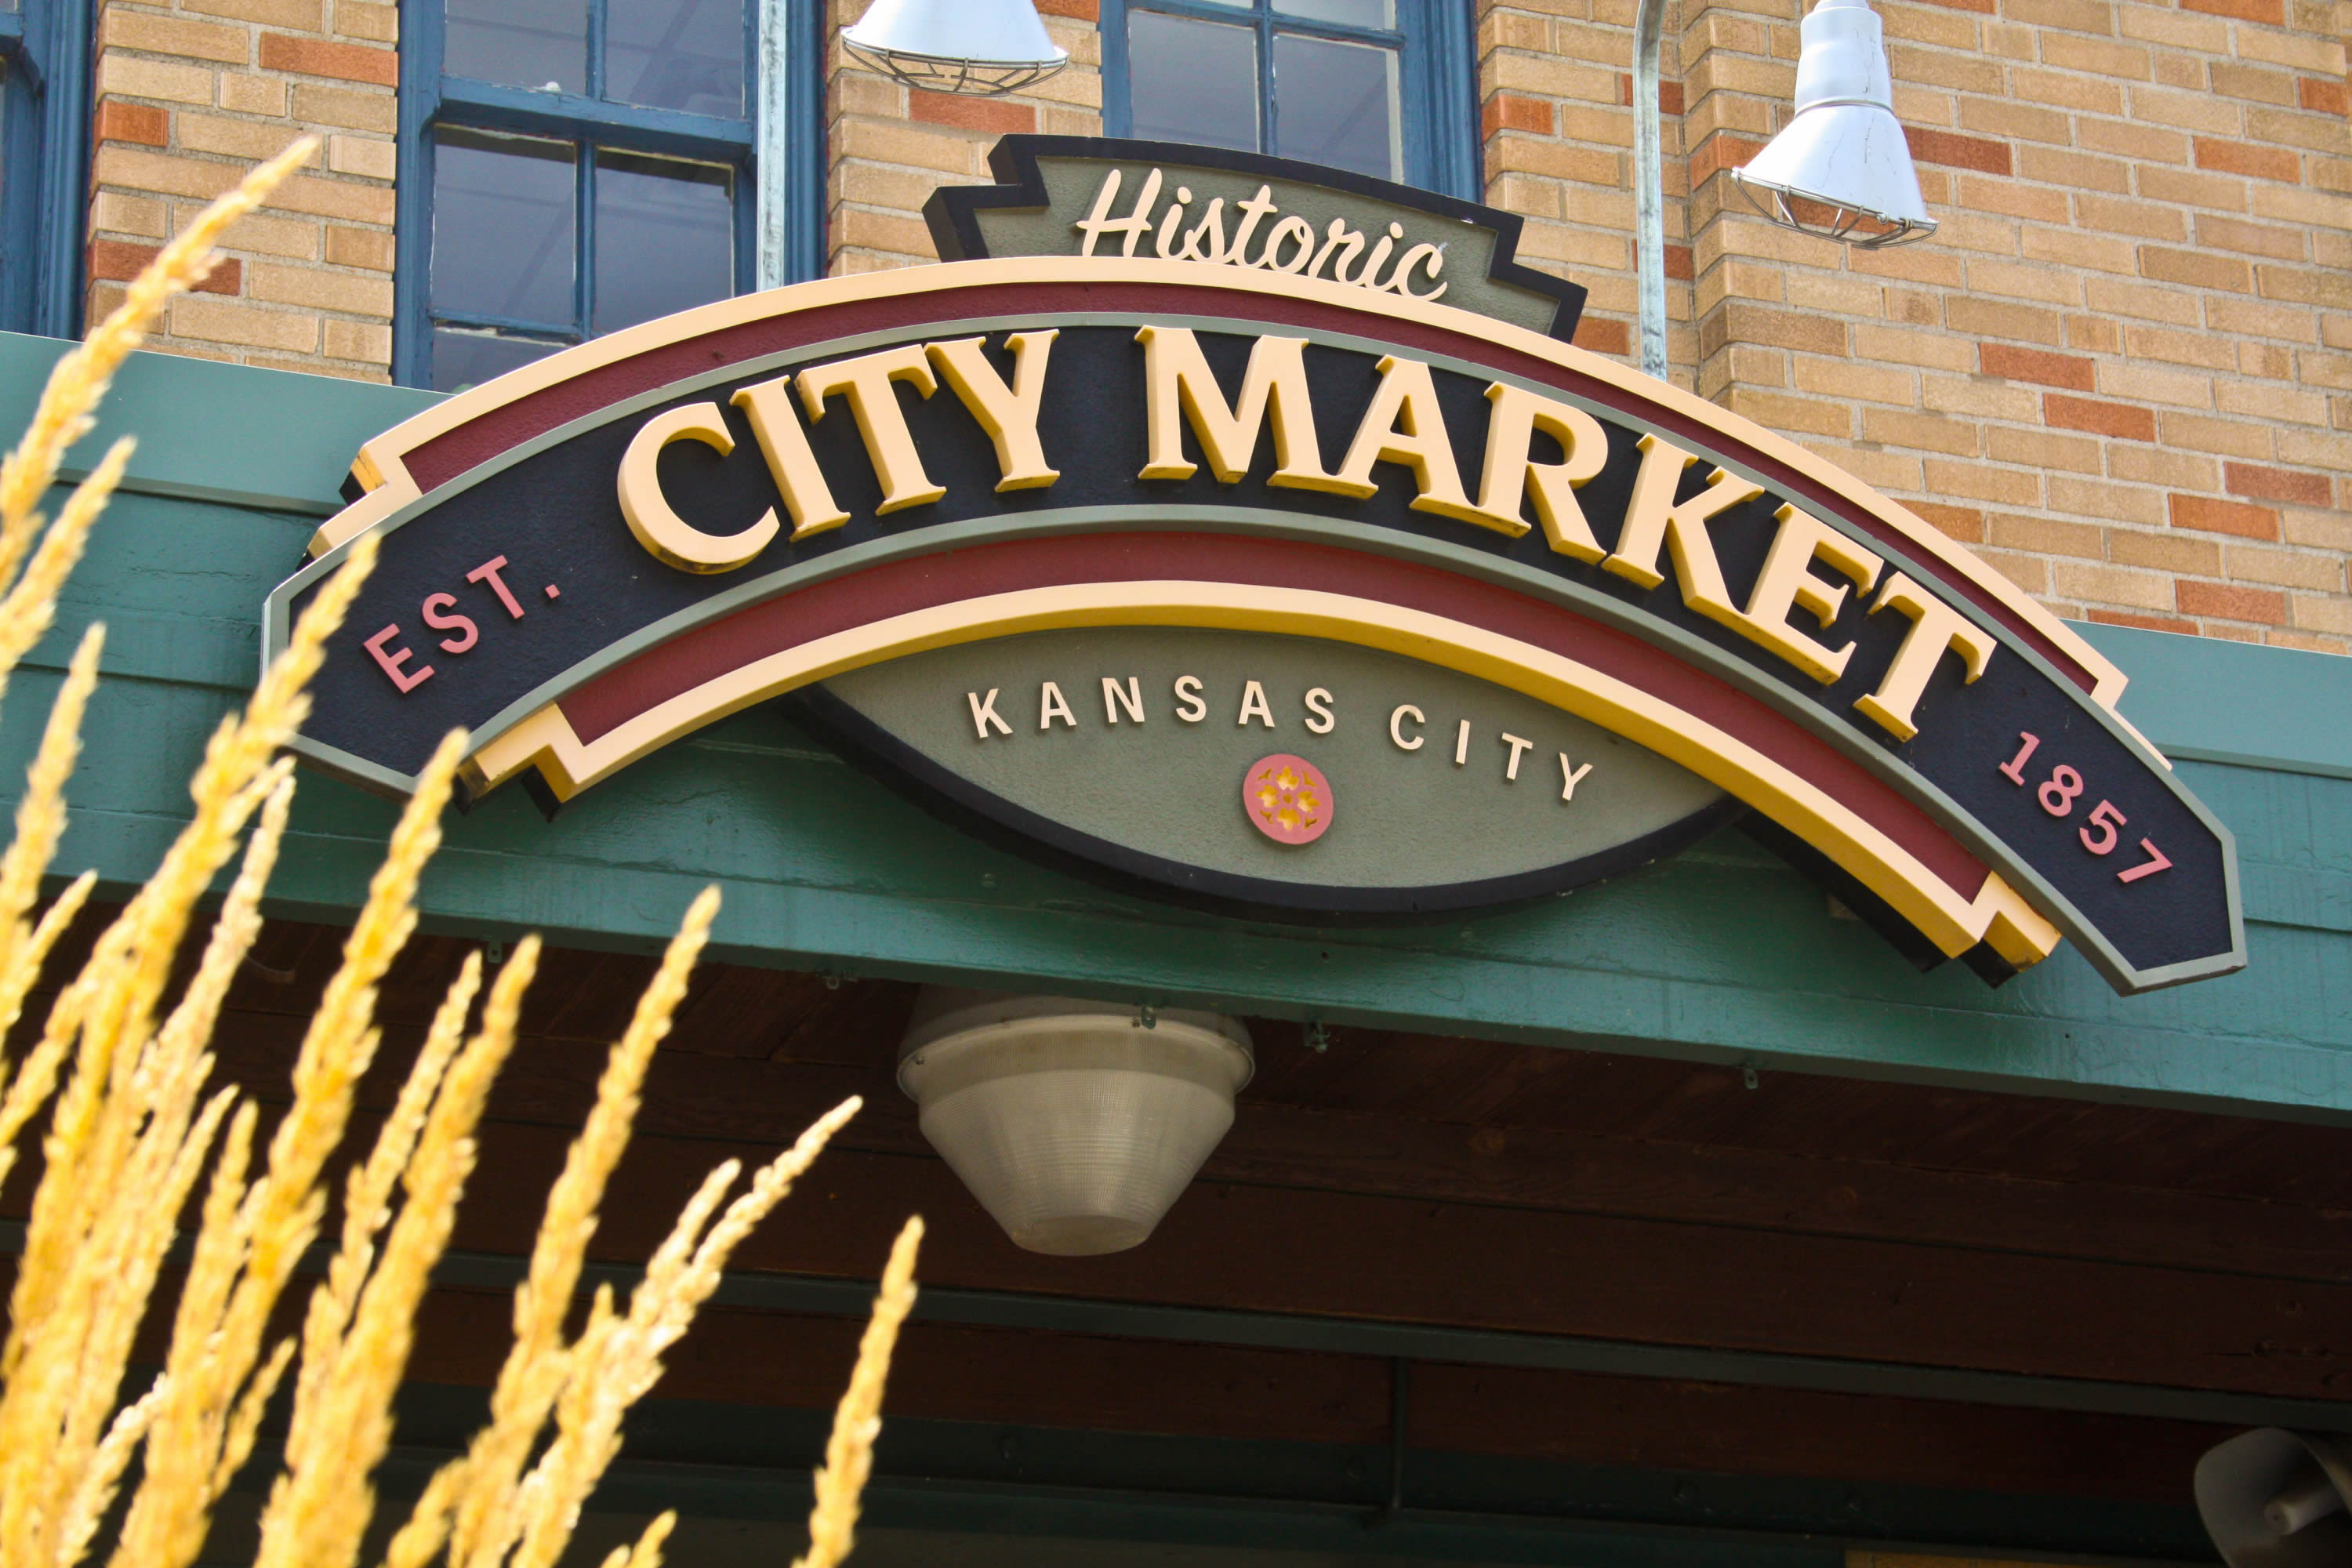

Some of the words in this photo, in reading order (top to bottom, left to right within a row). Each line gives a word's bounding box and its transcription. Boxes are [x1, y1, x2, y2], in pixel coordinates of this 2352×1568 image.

[1076, 168, 1447, 301] Historic
[617, 329, 1061, 575] CITY
[1134, 325, 1998, 742] MARKET
[363, 555, 560, 693] EST.
[968, 675, 1335, 739] KANSAS
[1390, 705, 1592, 800] CITY
[1998, 731, 2173, 884] 1857
